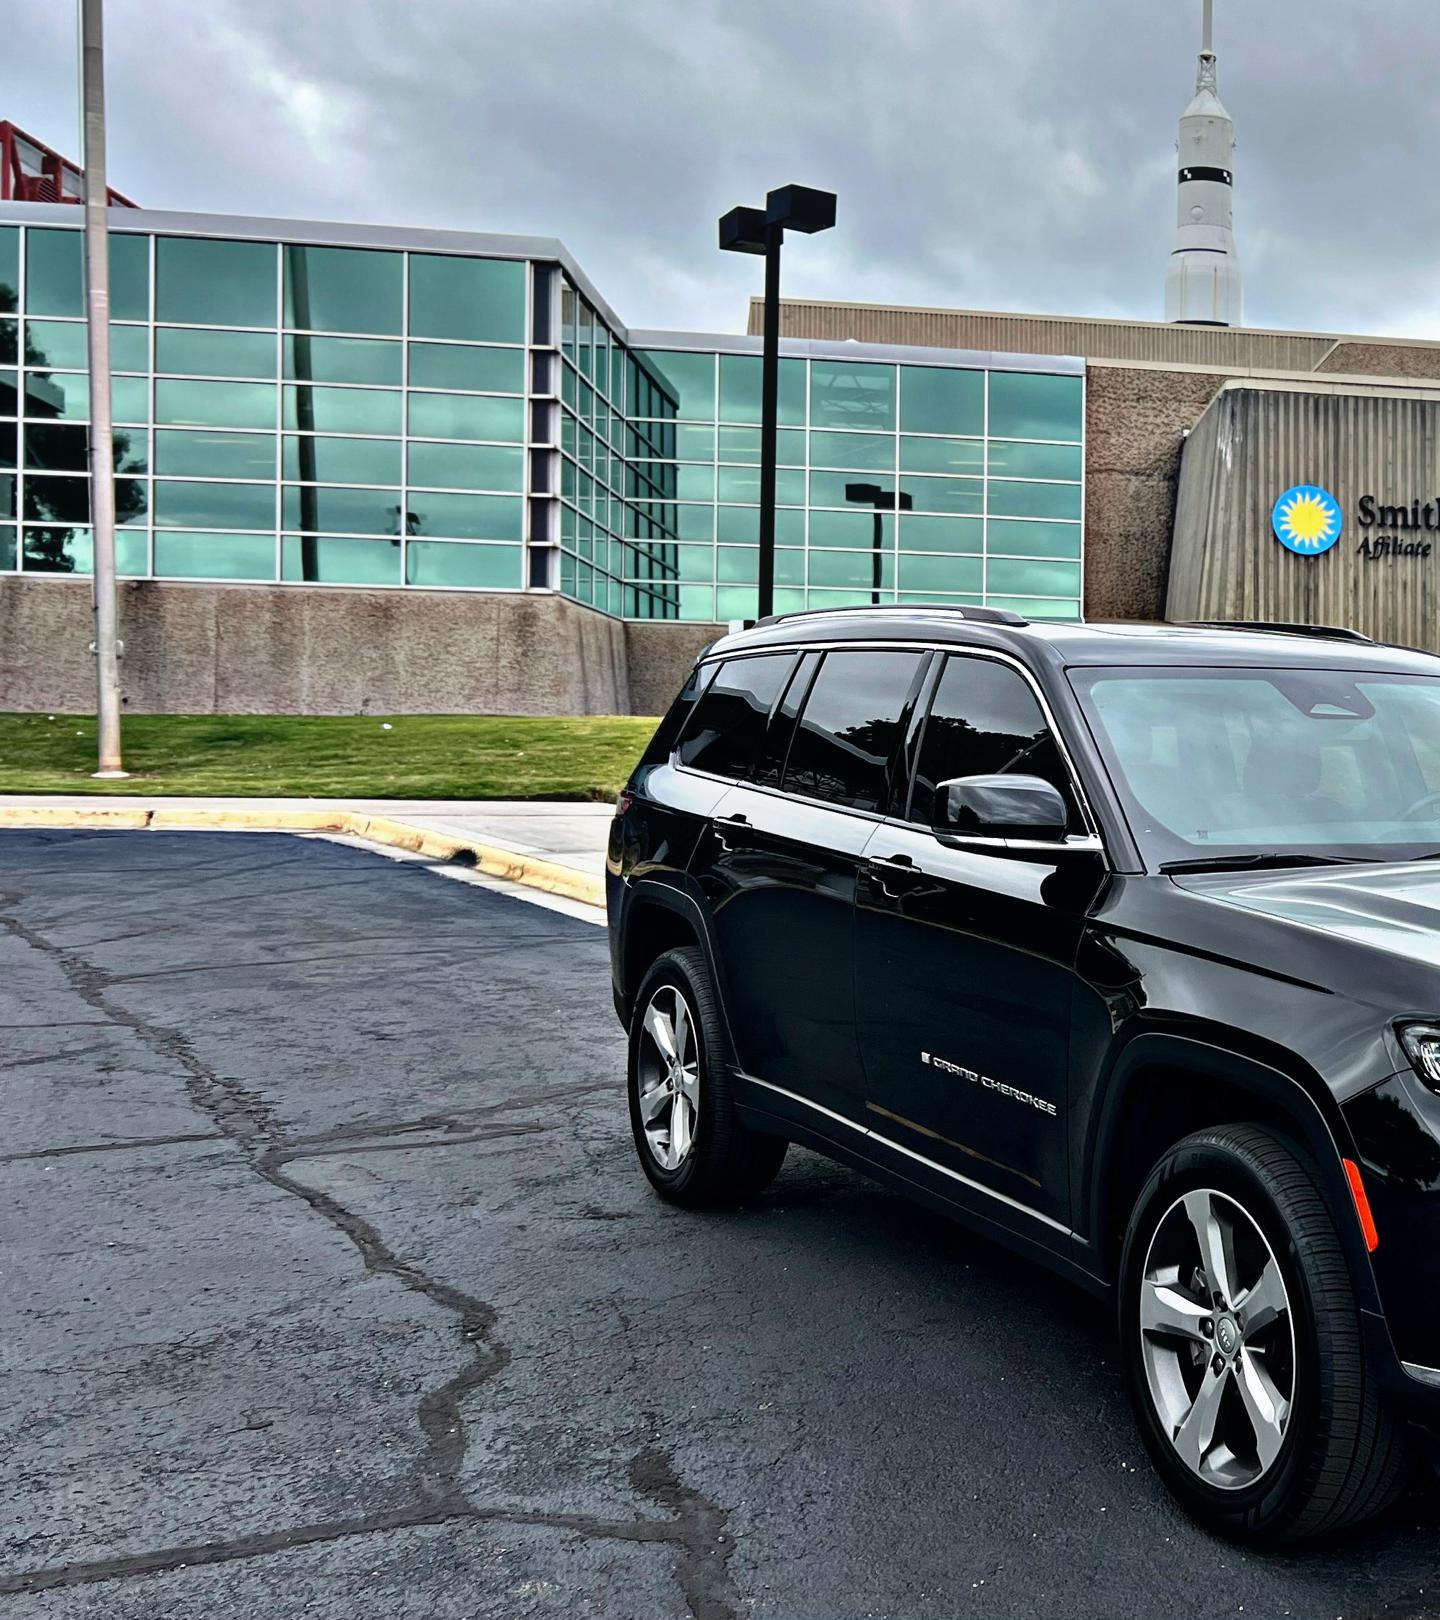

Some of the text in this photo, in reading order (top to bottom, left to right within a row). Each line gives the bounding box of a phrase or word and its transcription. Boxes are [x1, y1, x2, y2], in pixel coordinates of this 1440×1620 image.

[1357, 535, 1432, 560] Affiliate
[932, 1056, 1057, 1116] GRAND CHEROKEE
